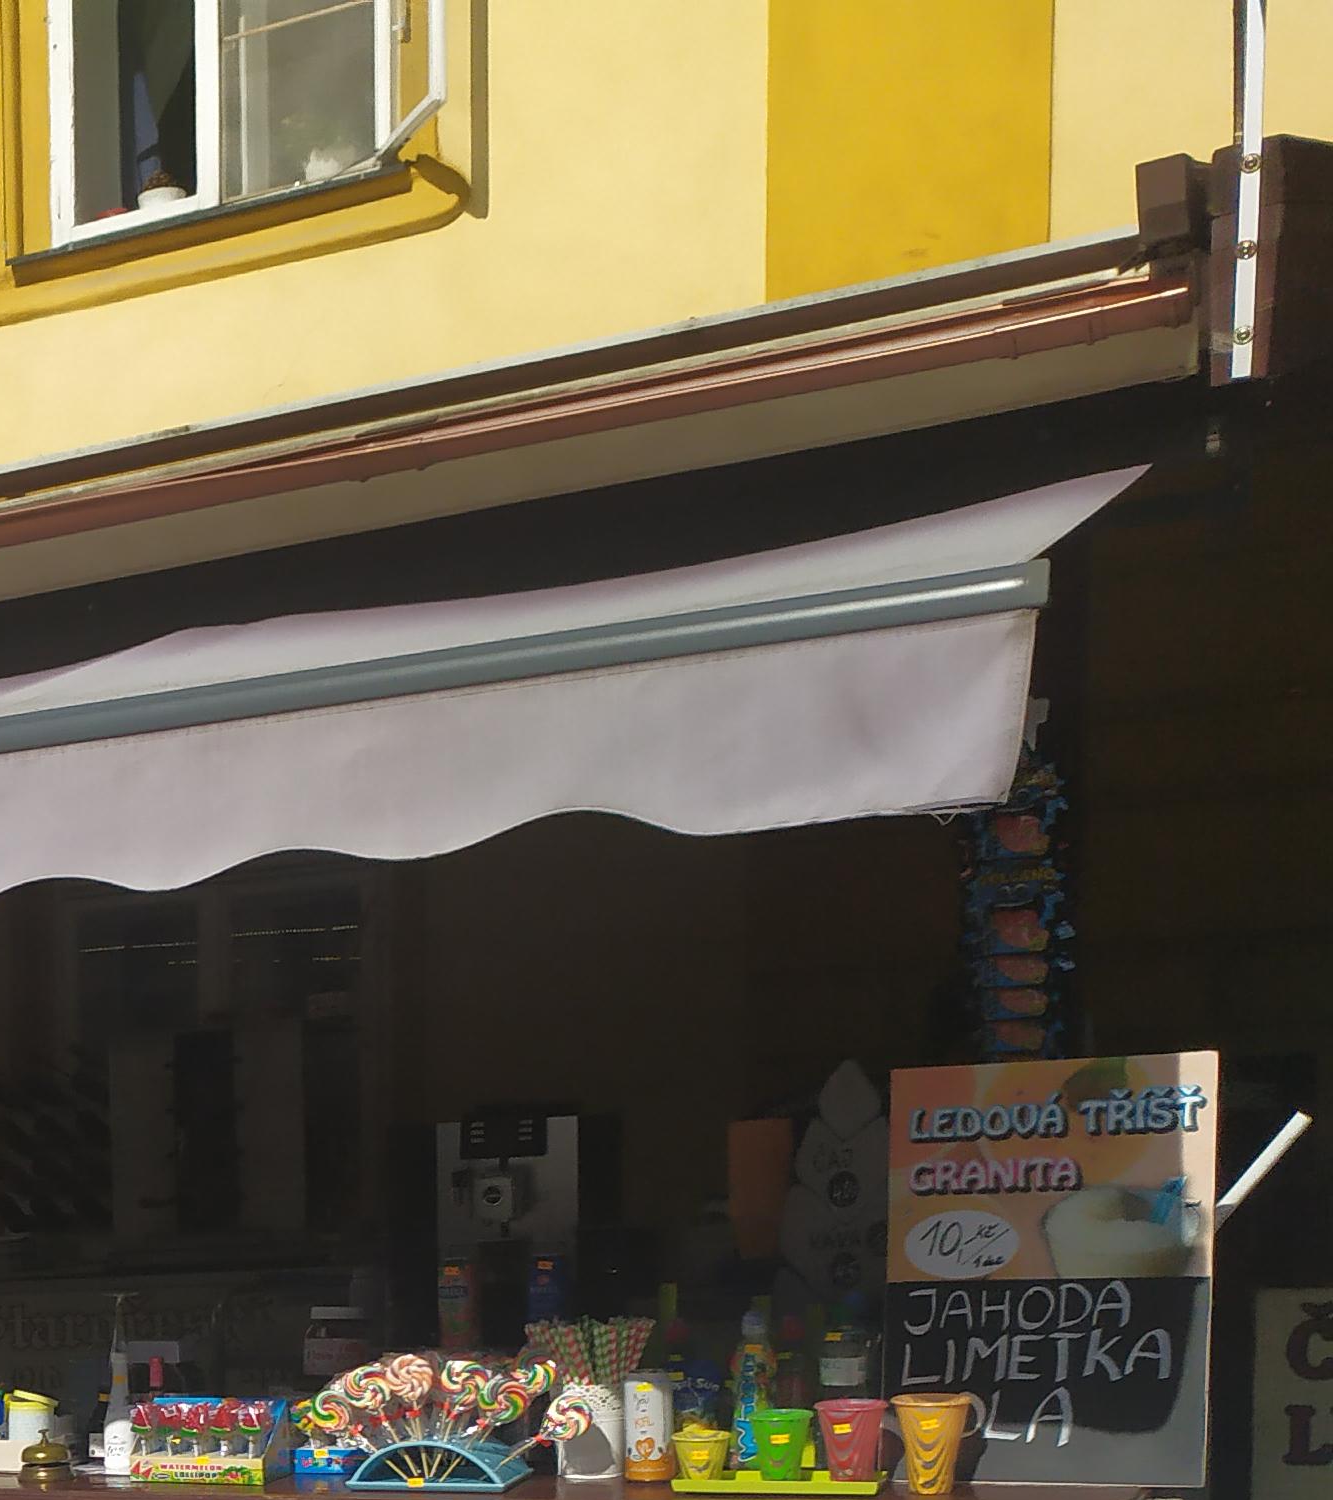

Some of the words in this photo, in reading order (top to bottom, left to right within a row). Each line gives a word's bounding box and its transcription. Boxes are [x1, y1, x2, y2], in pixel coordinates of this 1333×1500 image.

[908, 1093, 1070, 1144] LEDOVÁ
[1077, 1084, 1208, 1136] TŘÍŠŤ
[908, 1156, 1083, 1196] GRANITA
[902, 1280, 1133, 1337] JAHODA
[900, 1328, 1173, 1388] LIMETKA
